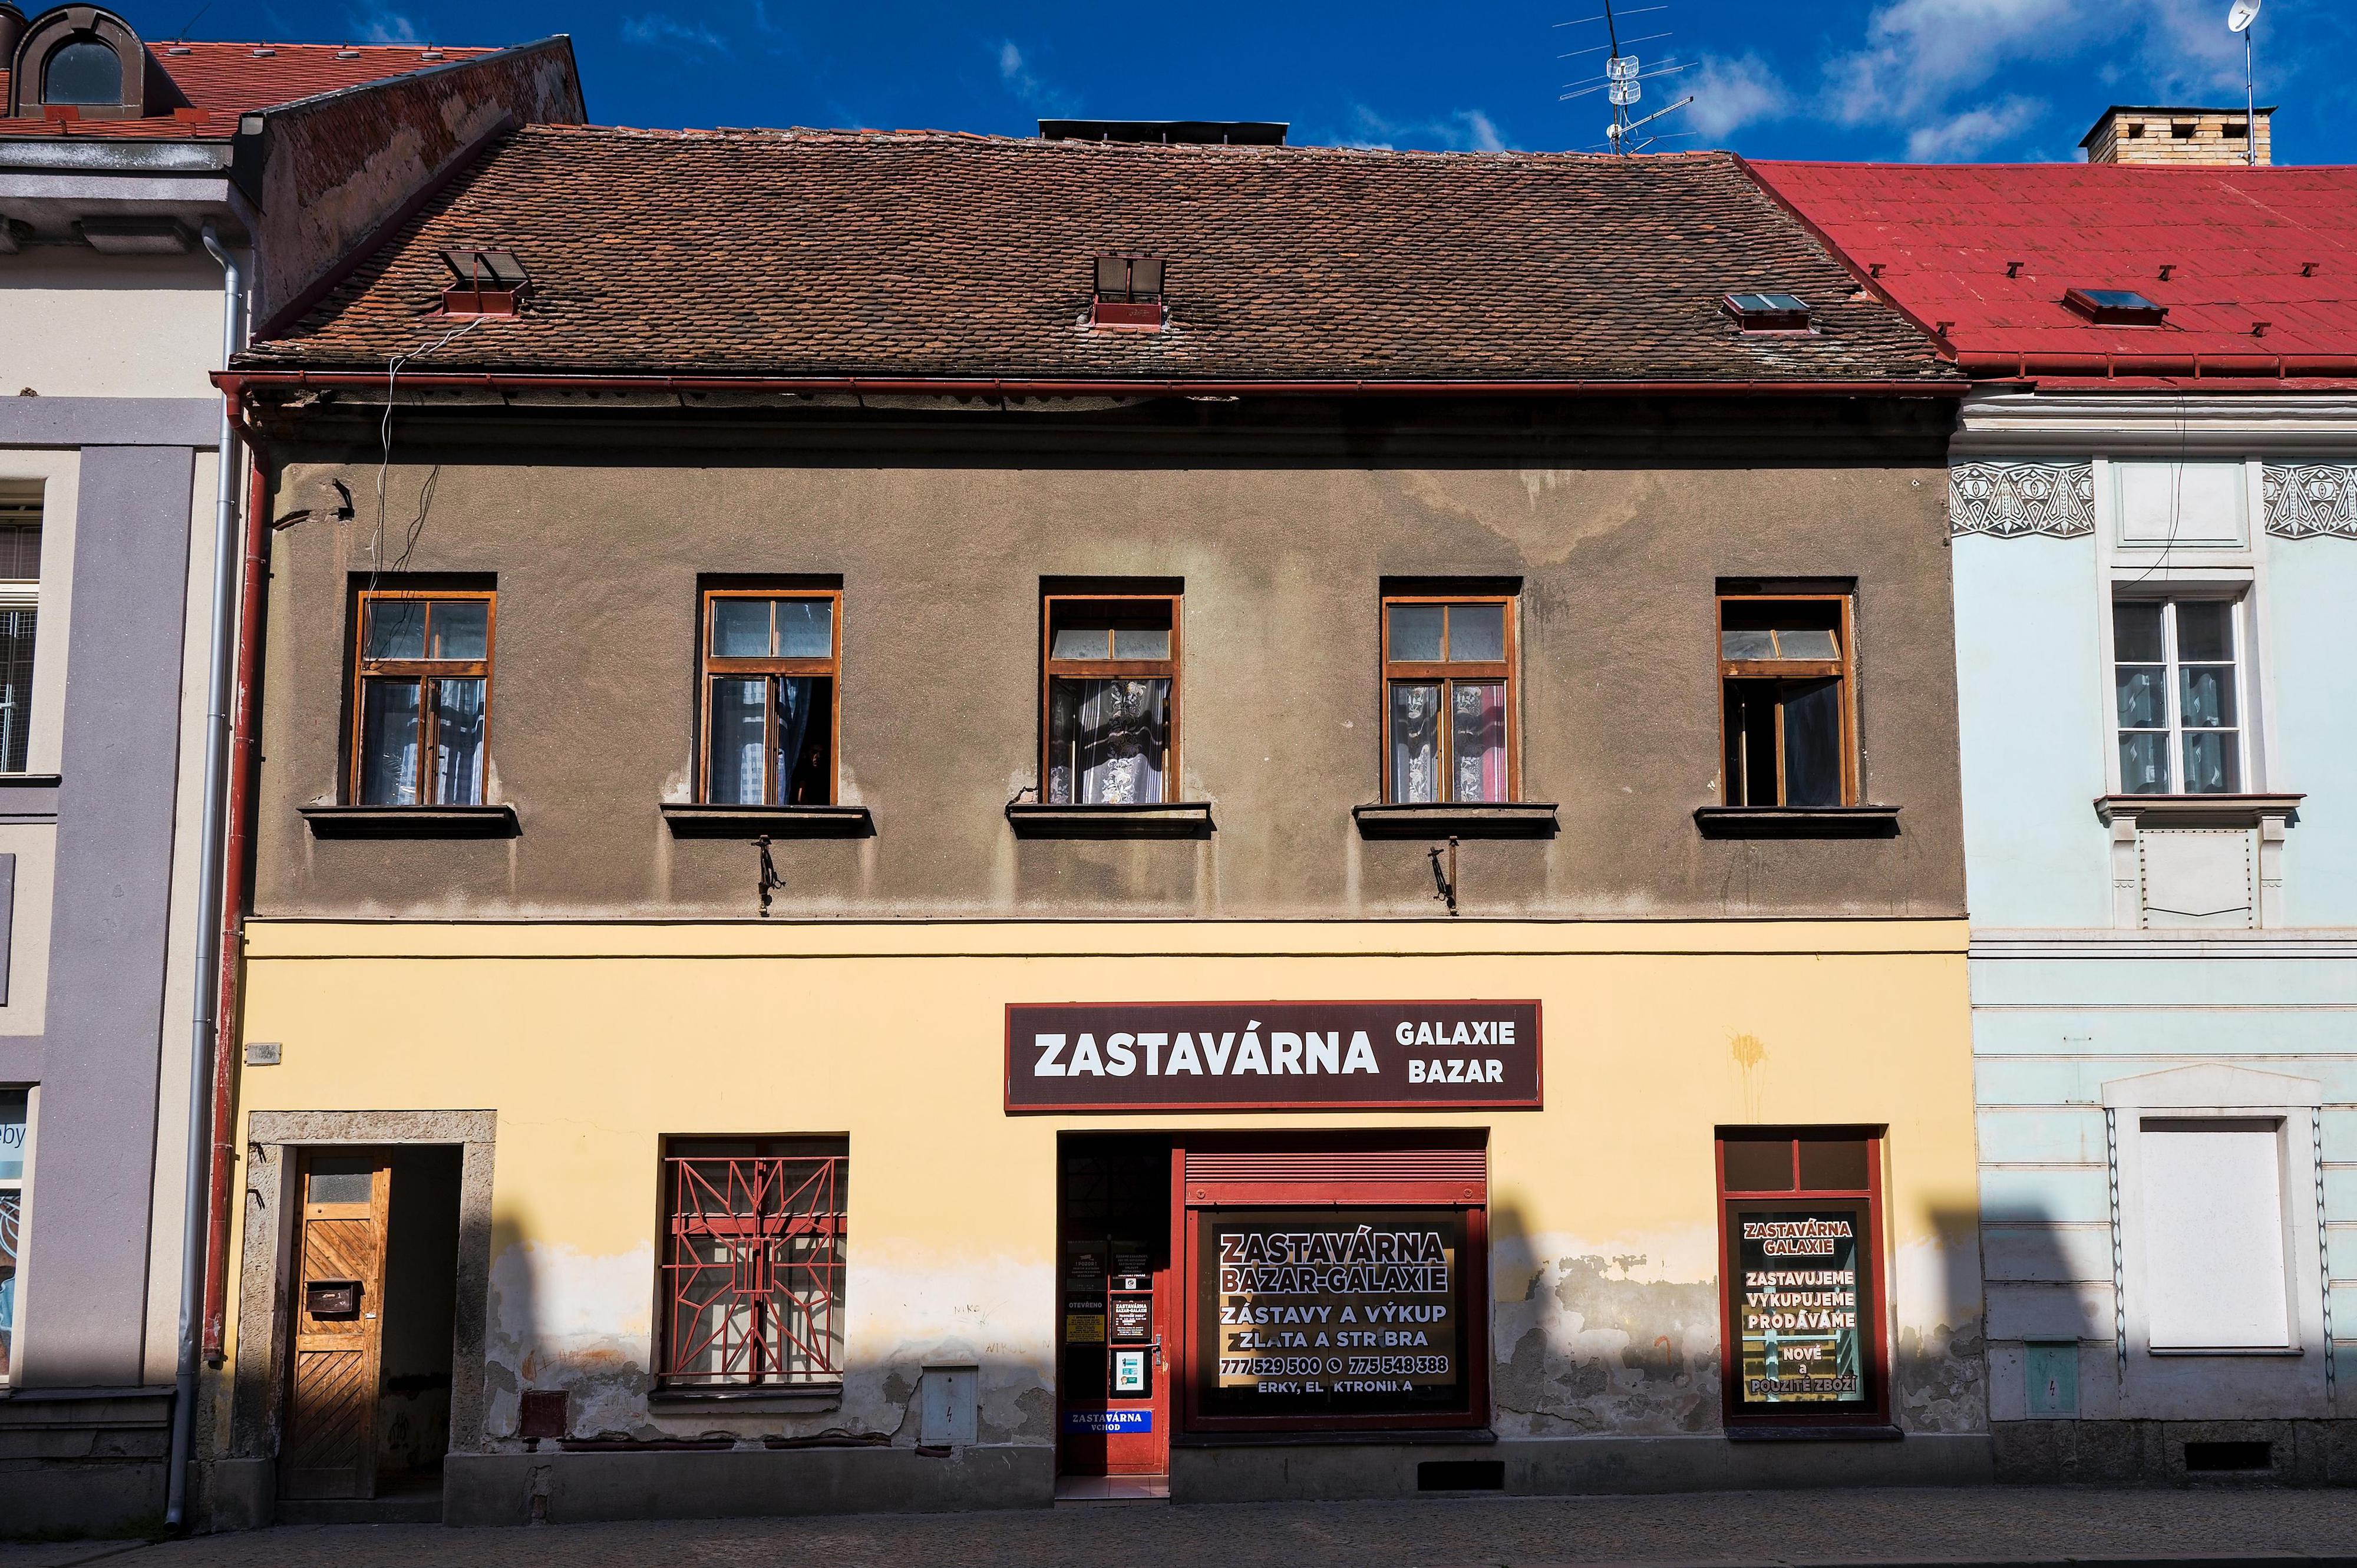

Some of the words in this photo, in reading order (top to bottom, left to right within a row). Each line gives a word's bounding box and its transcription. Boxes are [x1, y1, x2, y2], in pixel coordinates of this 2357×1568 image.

[1395, 1021, 1516, 1046] GALAXIE
[1034, 1019, 1379, 1077] ZASTAVÁRNA
[1408, 1059, 1504, 1083] BAZAR
[0, 1123, 26, 1148] by
[1744, 1217, 1853, 1239] ZASTAVÁRNA
[1220, 1224, 1448, 1265] ZASTAVÁRNA
[1763, 1239, 1834, 1256] GALAXIE
[1220, 1266, 1448, 1294] BAZAR-GALAXIE
[1746, 1271, 1855, 1286] ZASTAVUJEME
[1746, 1292, 1855, 1307] VYKUPUJEME
[1220, 1302, 1332, 1324] ZÁSTAVY
[1339, 1305, 1357, 1323] A
[1364, 1302, 1447, 1323] VÝKUP
[1748, 1309, 1856, 1329] PRODÁVÁME
[1314, 1331, 1330, 1347] A
[1783, 1344, 1823, 1361] NOVÉ
[1219, 1358, 1252, 1375] 777
[1252, 1357, 1285, 1375] 529
[1286, 1357, 1322, 1375] 500
[1348, 1356, 1380, 1375] 775
[1381, 1356, 1415, 1374] 548
[1416, 1355, 1449, 1374] 388
[1798, 1364, 1807, 1375] a
[1814, 1375, 1857, 1392] ZBOŽÍ
[1072, 1412, 1142, 1422] ZASTAVÁRNA
